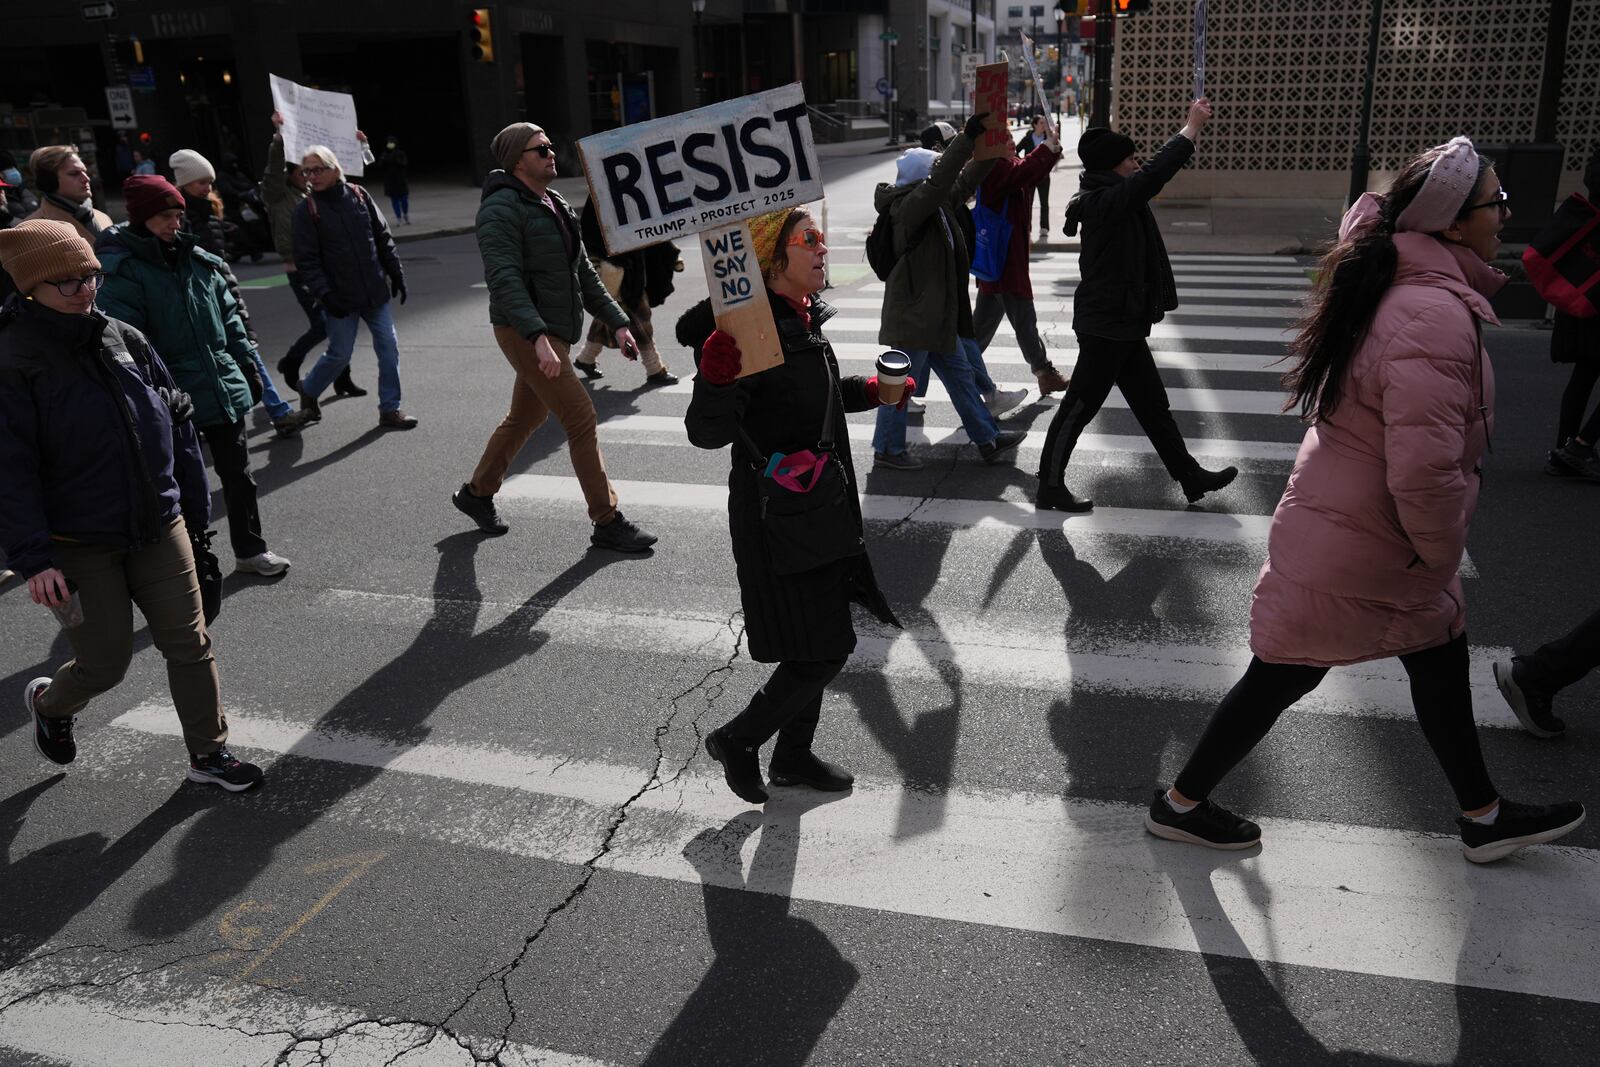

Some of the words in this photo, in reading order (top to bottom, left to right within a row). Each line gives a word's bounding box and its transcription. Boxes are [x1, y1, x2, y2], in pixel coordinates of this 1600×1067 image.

[109, 90, 128, 100] ONE
[112, 101, 129, 111] WAY
[602, 103, 812, 227] RESIST
[634, 219, 686, 240] TRUMP
[689, 215, 698, 226] +
[700, 199, 756, 222] PROJECT
[764, 188, 795, 207] 2025
[705, 230, 744, 257] WE
[714, 252, 747, 279] SAY
[722, 277, 752, 299] NO
